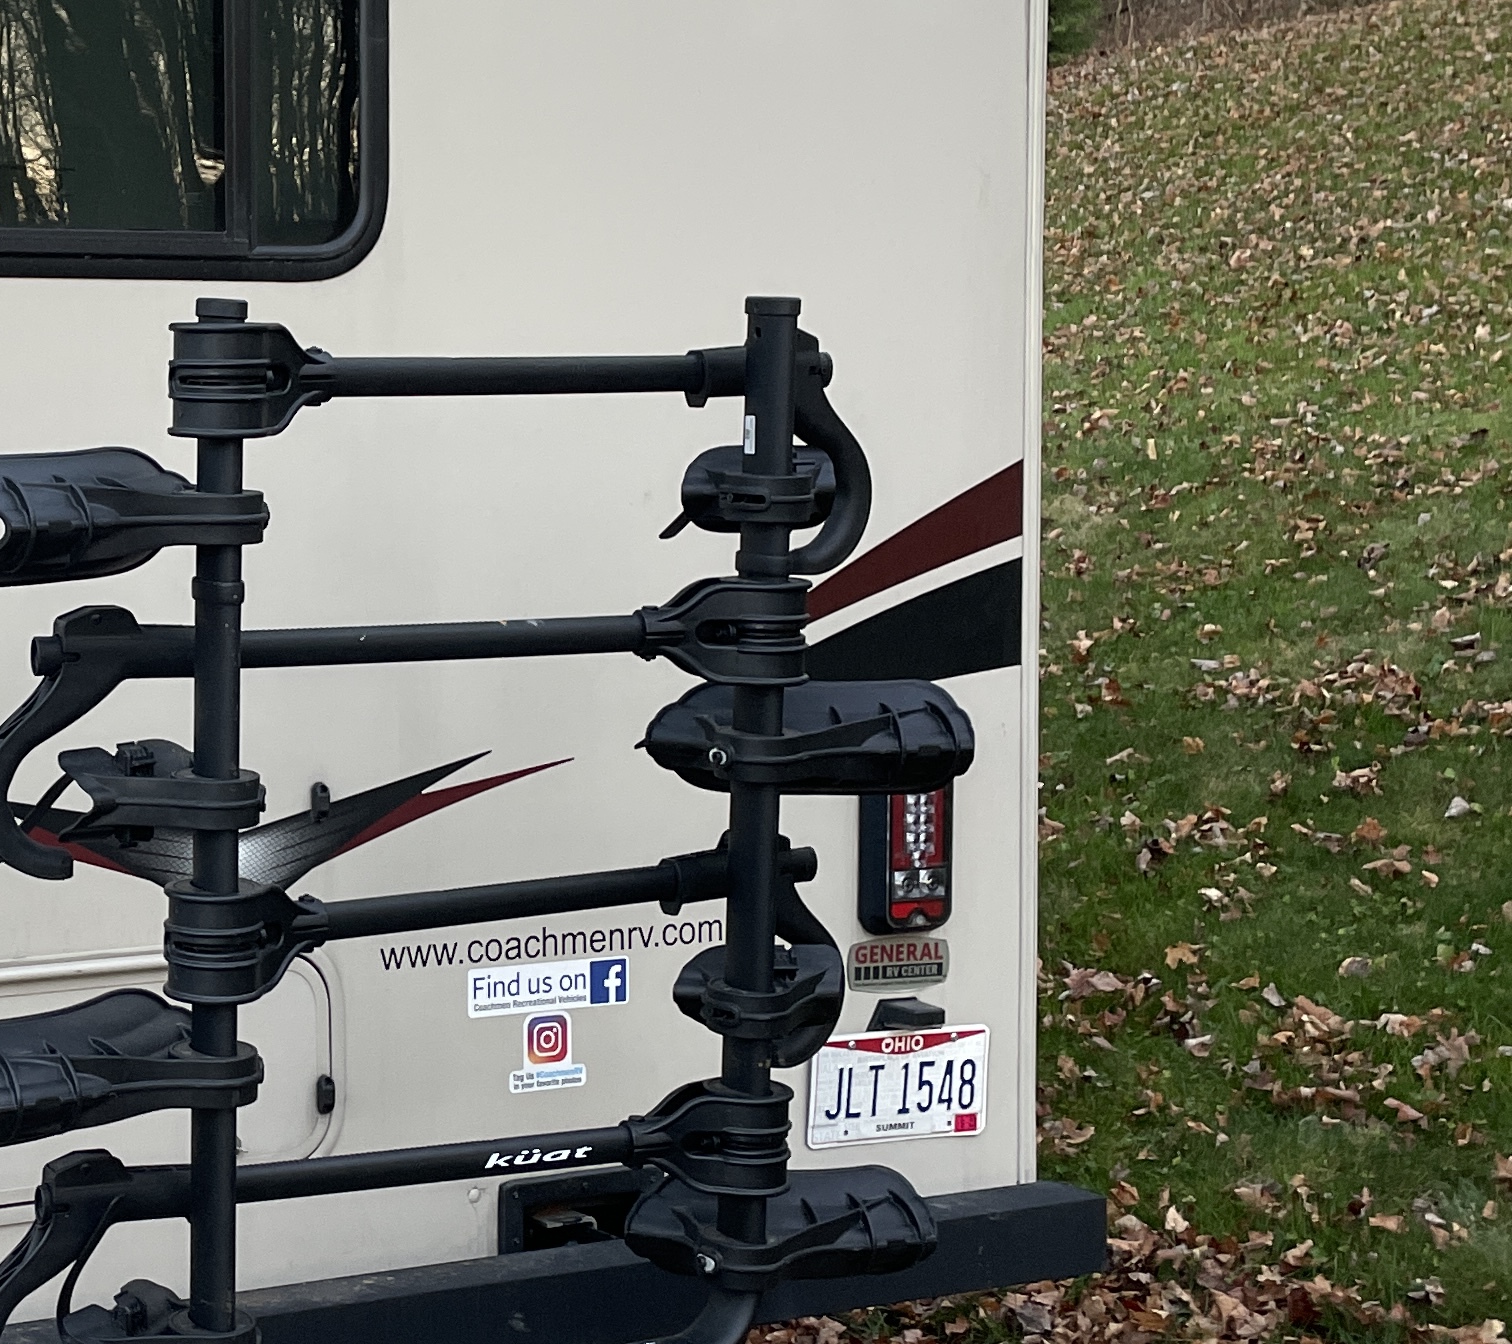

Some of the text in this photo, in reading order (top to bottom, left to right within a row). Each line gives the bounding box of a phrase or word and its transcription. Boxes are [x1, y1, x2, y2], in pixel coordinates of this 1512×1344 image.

[380, 919, 723, 971] www.coachmenrv.com
[854, 942, 943, 964] GENERAL
[885, 964, 938, 977] RV CENTER
[473, 971, 520, 999] Find
[528, 976, 552, 995] us
[559, 972, 586, 992] on
[881, 1035, 924, 1053] OHIO
[825, 1058, 976, 1120] JLT 1548
[875, 1121, 915, 1132] SUMMIT
[484, 1146, 593, 1169] küat
